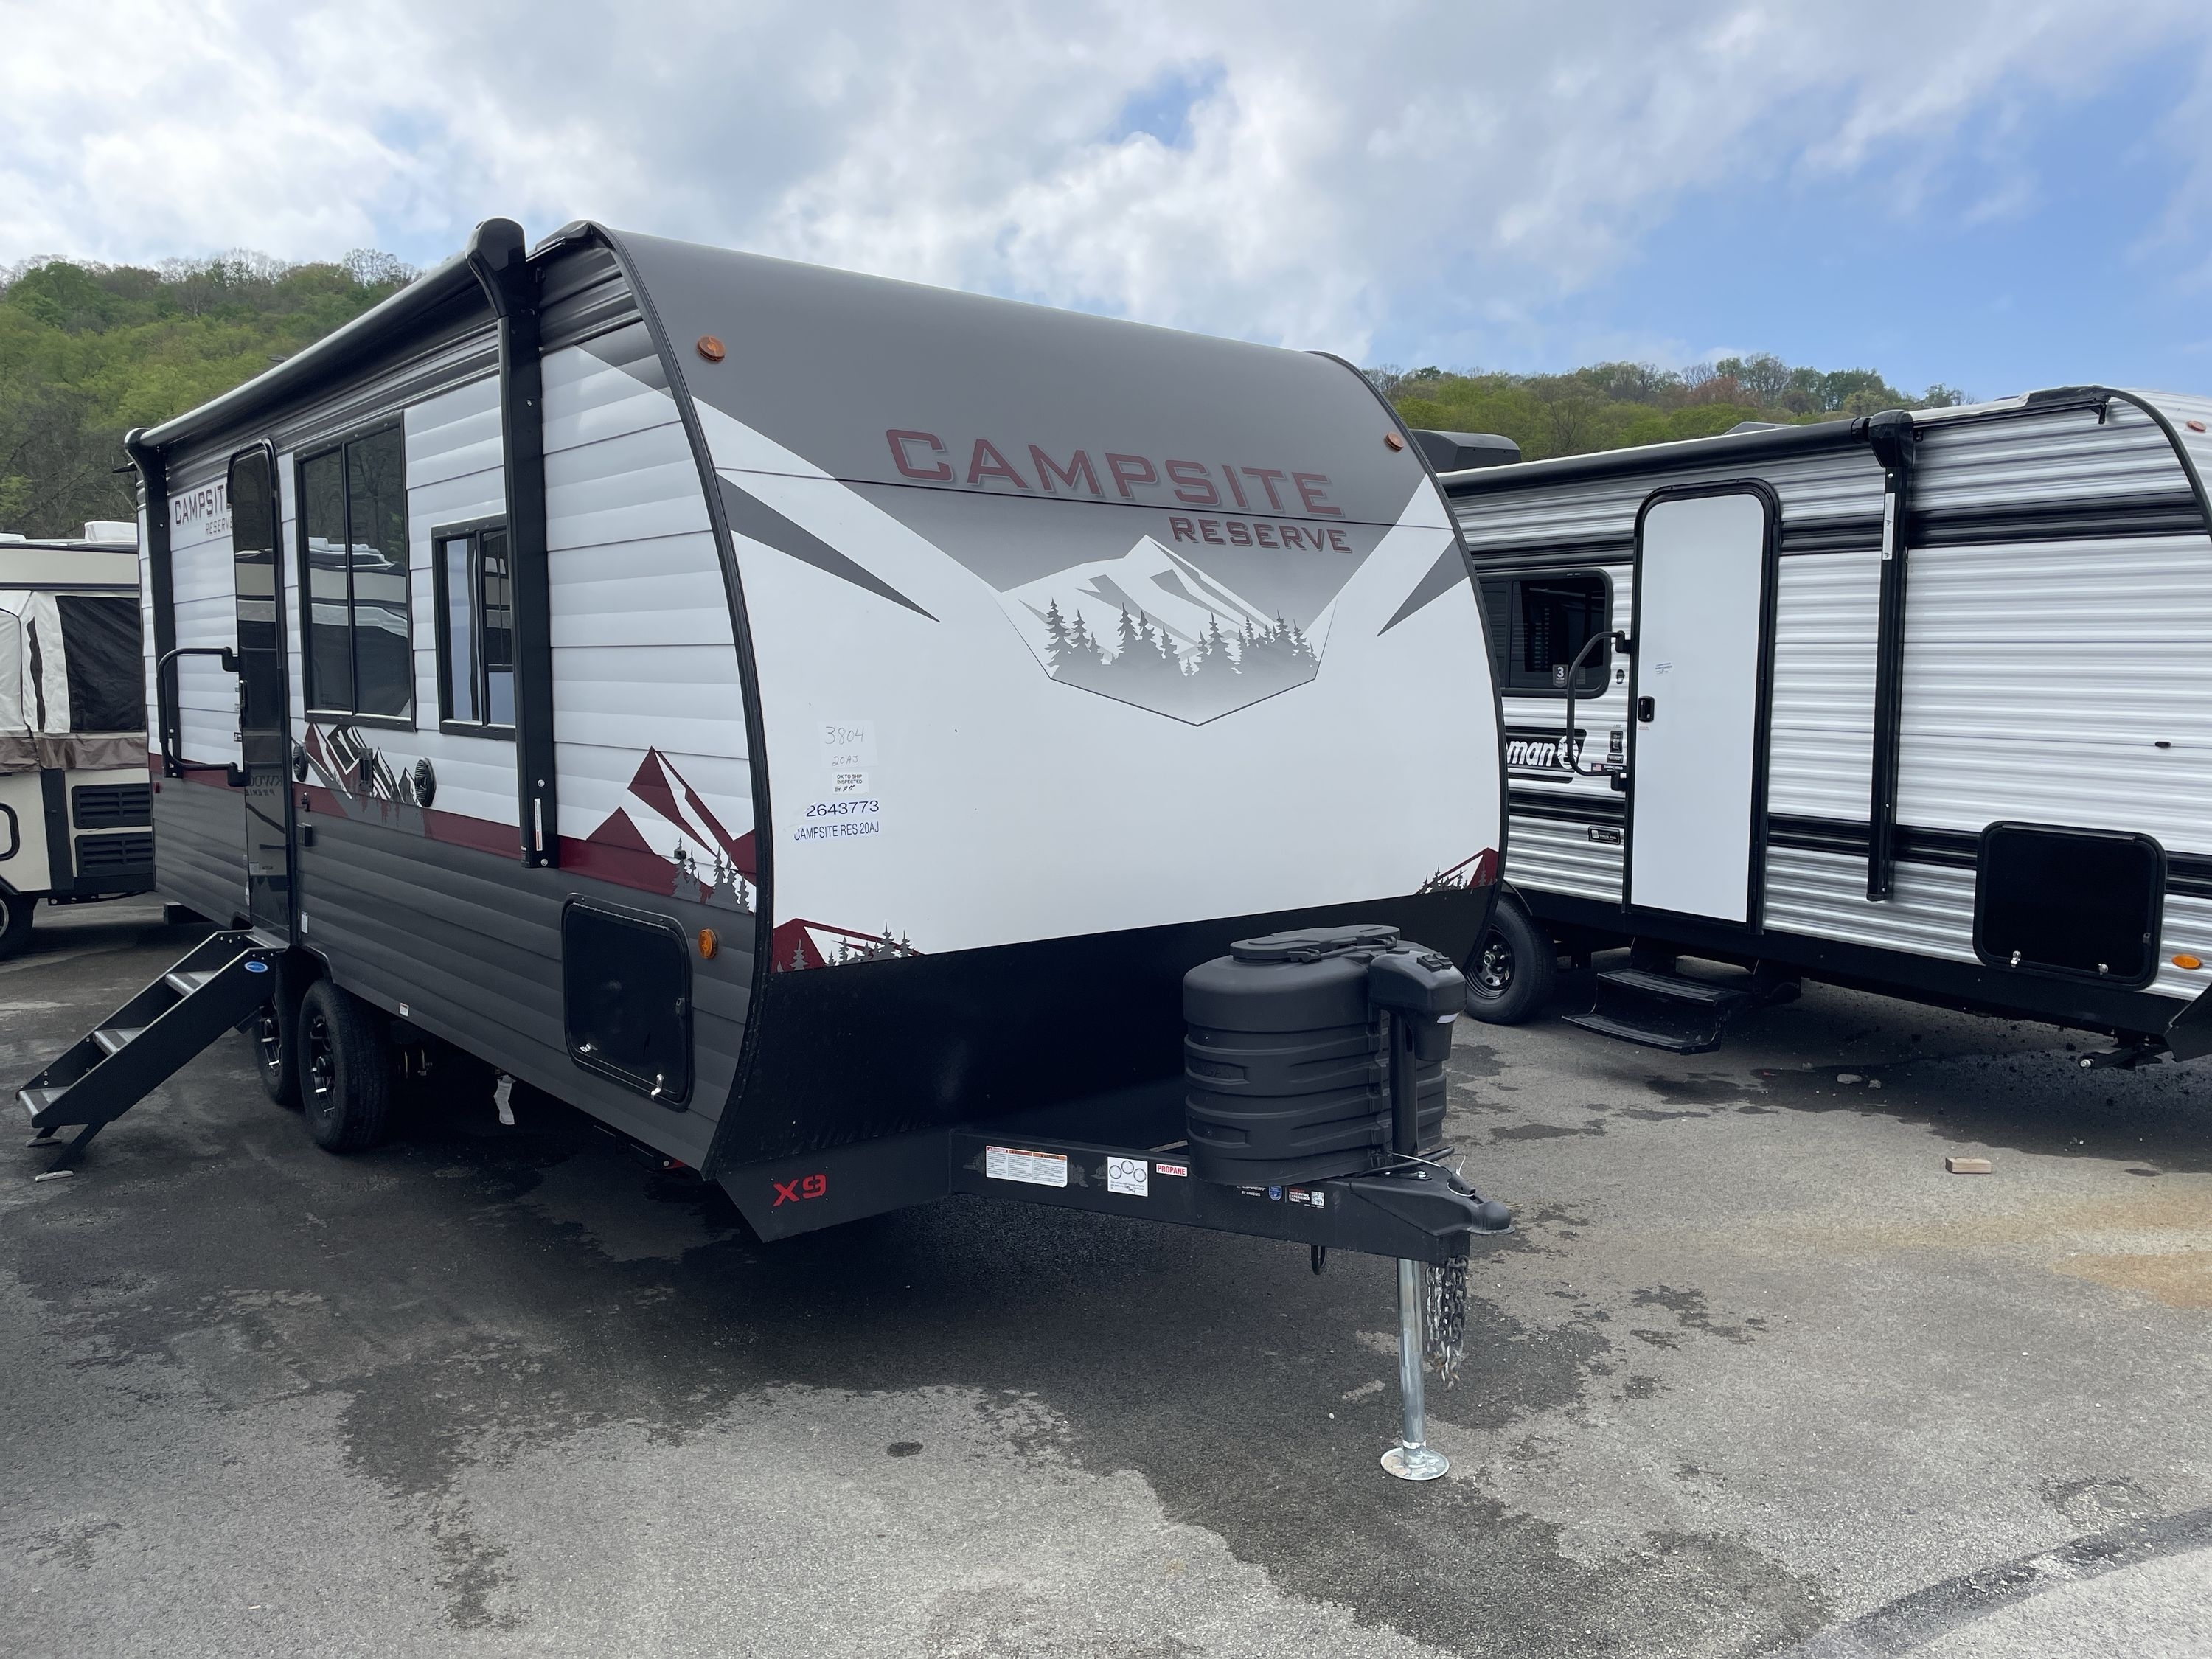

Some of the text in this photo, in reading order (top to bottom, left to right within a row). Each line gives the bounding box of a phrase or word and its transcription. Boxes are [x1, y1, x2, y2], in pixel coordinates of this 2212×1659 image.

[886, 428, 1344, 516] CAMPSITE
[1168, 515, 1353, 554] RESERVE
[1557, 667, 1564, 678] 3
[825, 726, 864, 745] 3804
[832, 755, 859, 766] 20AJ
[1506, 740, 1556, 766] man
[806, 800, 879, 817] 2643773
[793, 821, 880, 841] CAMPSITE RES 20AJ
[1157, 1165, 1186, 1175] PROPANE
[773, 1174, 827, 1207] X9
